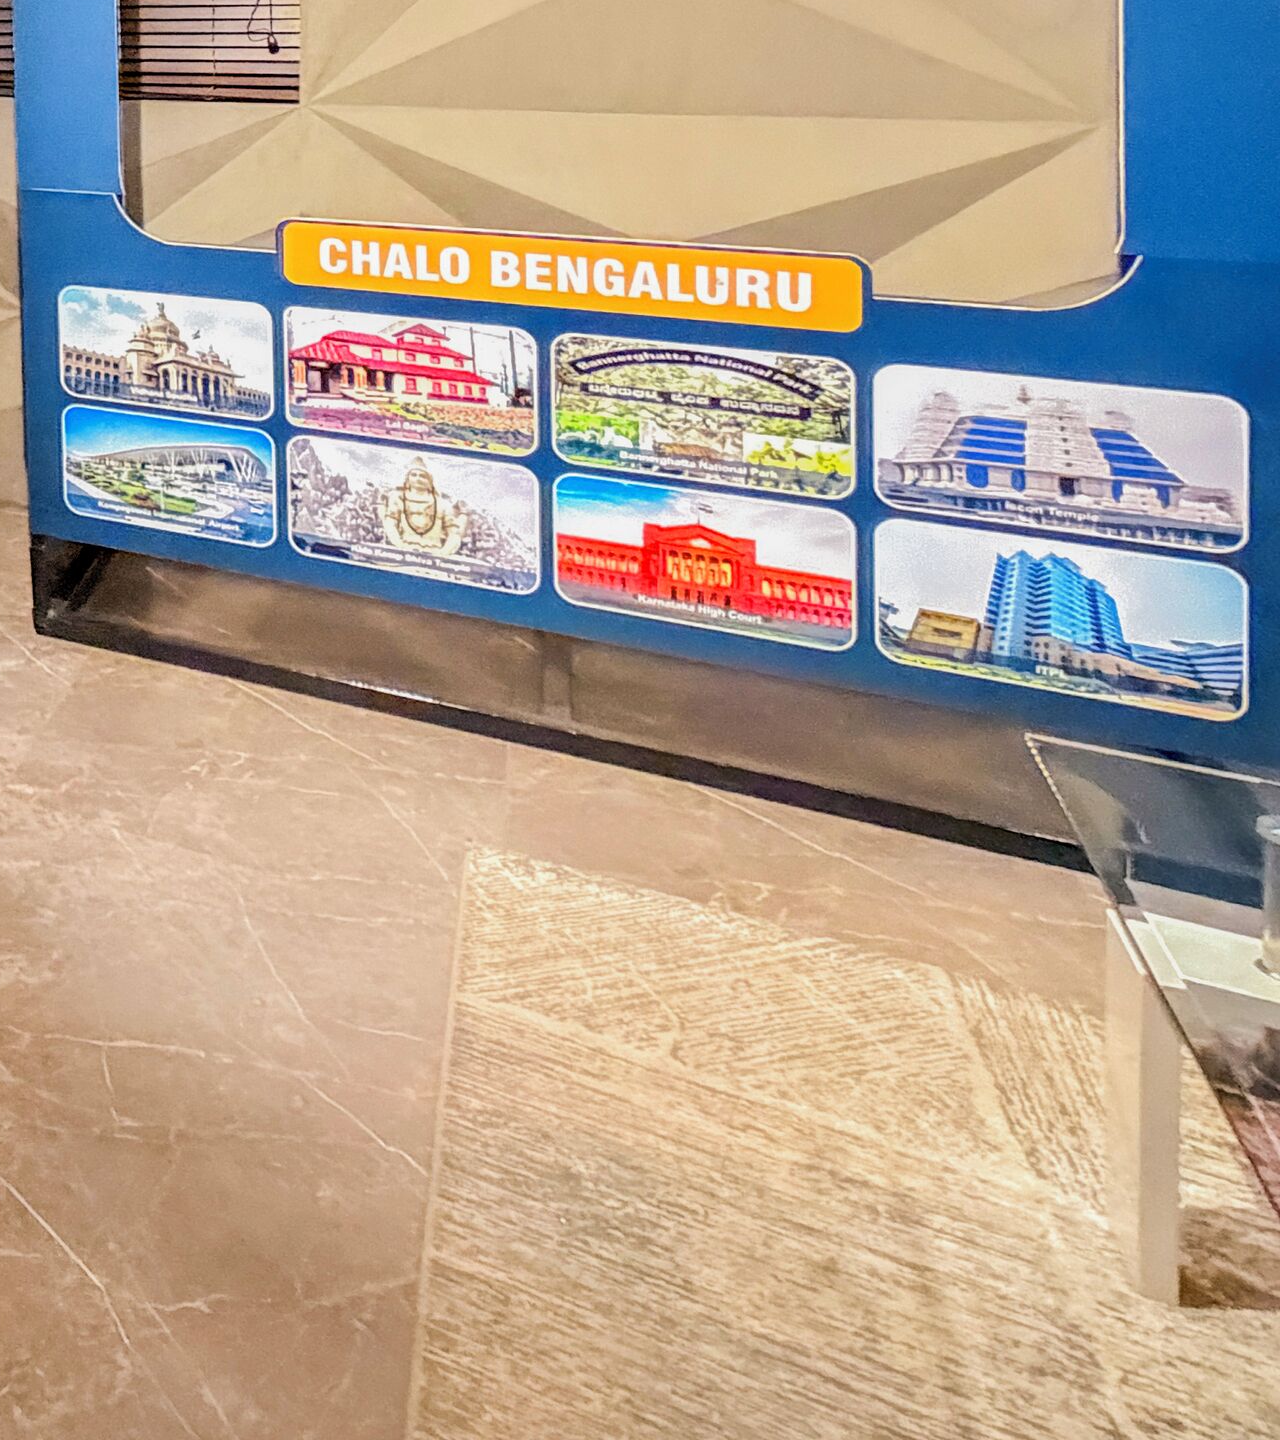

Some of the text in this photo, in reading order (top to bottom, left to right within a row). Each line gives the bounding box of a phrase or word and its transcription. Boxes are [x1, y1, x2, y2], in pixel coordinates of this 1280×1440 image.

[318, 236, 813, 313] CHALO BENGALURU
[693, 353, 773, 378] National
[698, 459, 748, 475] National
[750, 466, 778, 479] Park
[1048, 506, 1100, 522] Temple
[697, 603, 726, 618] High
